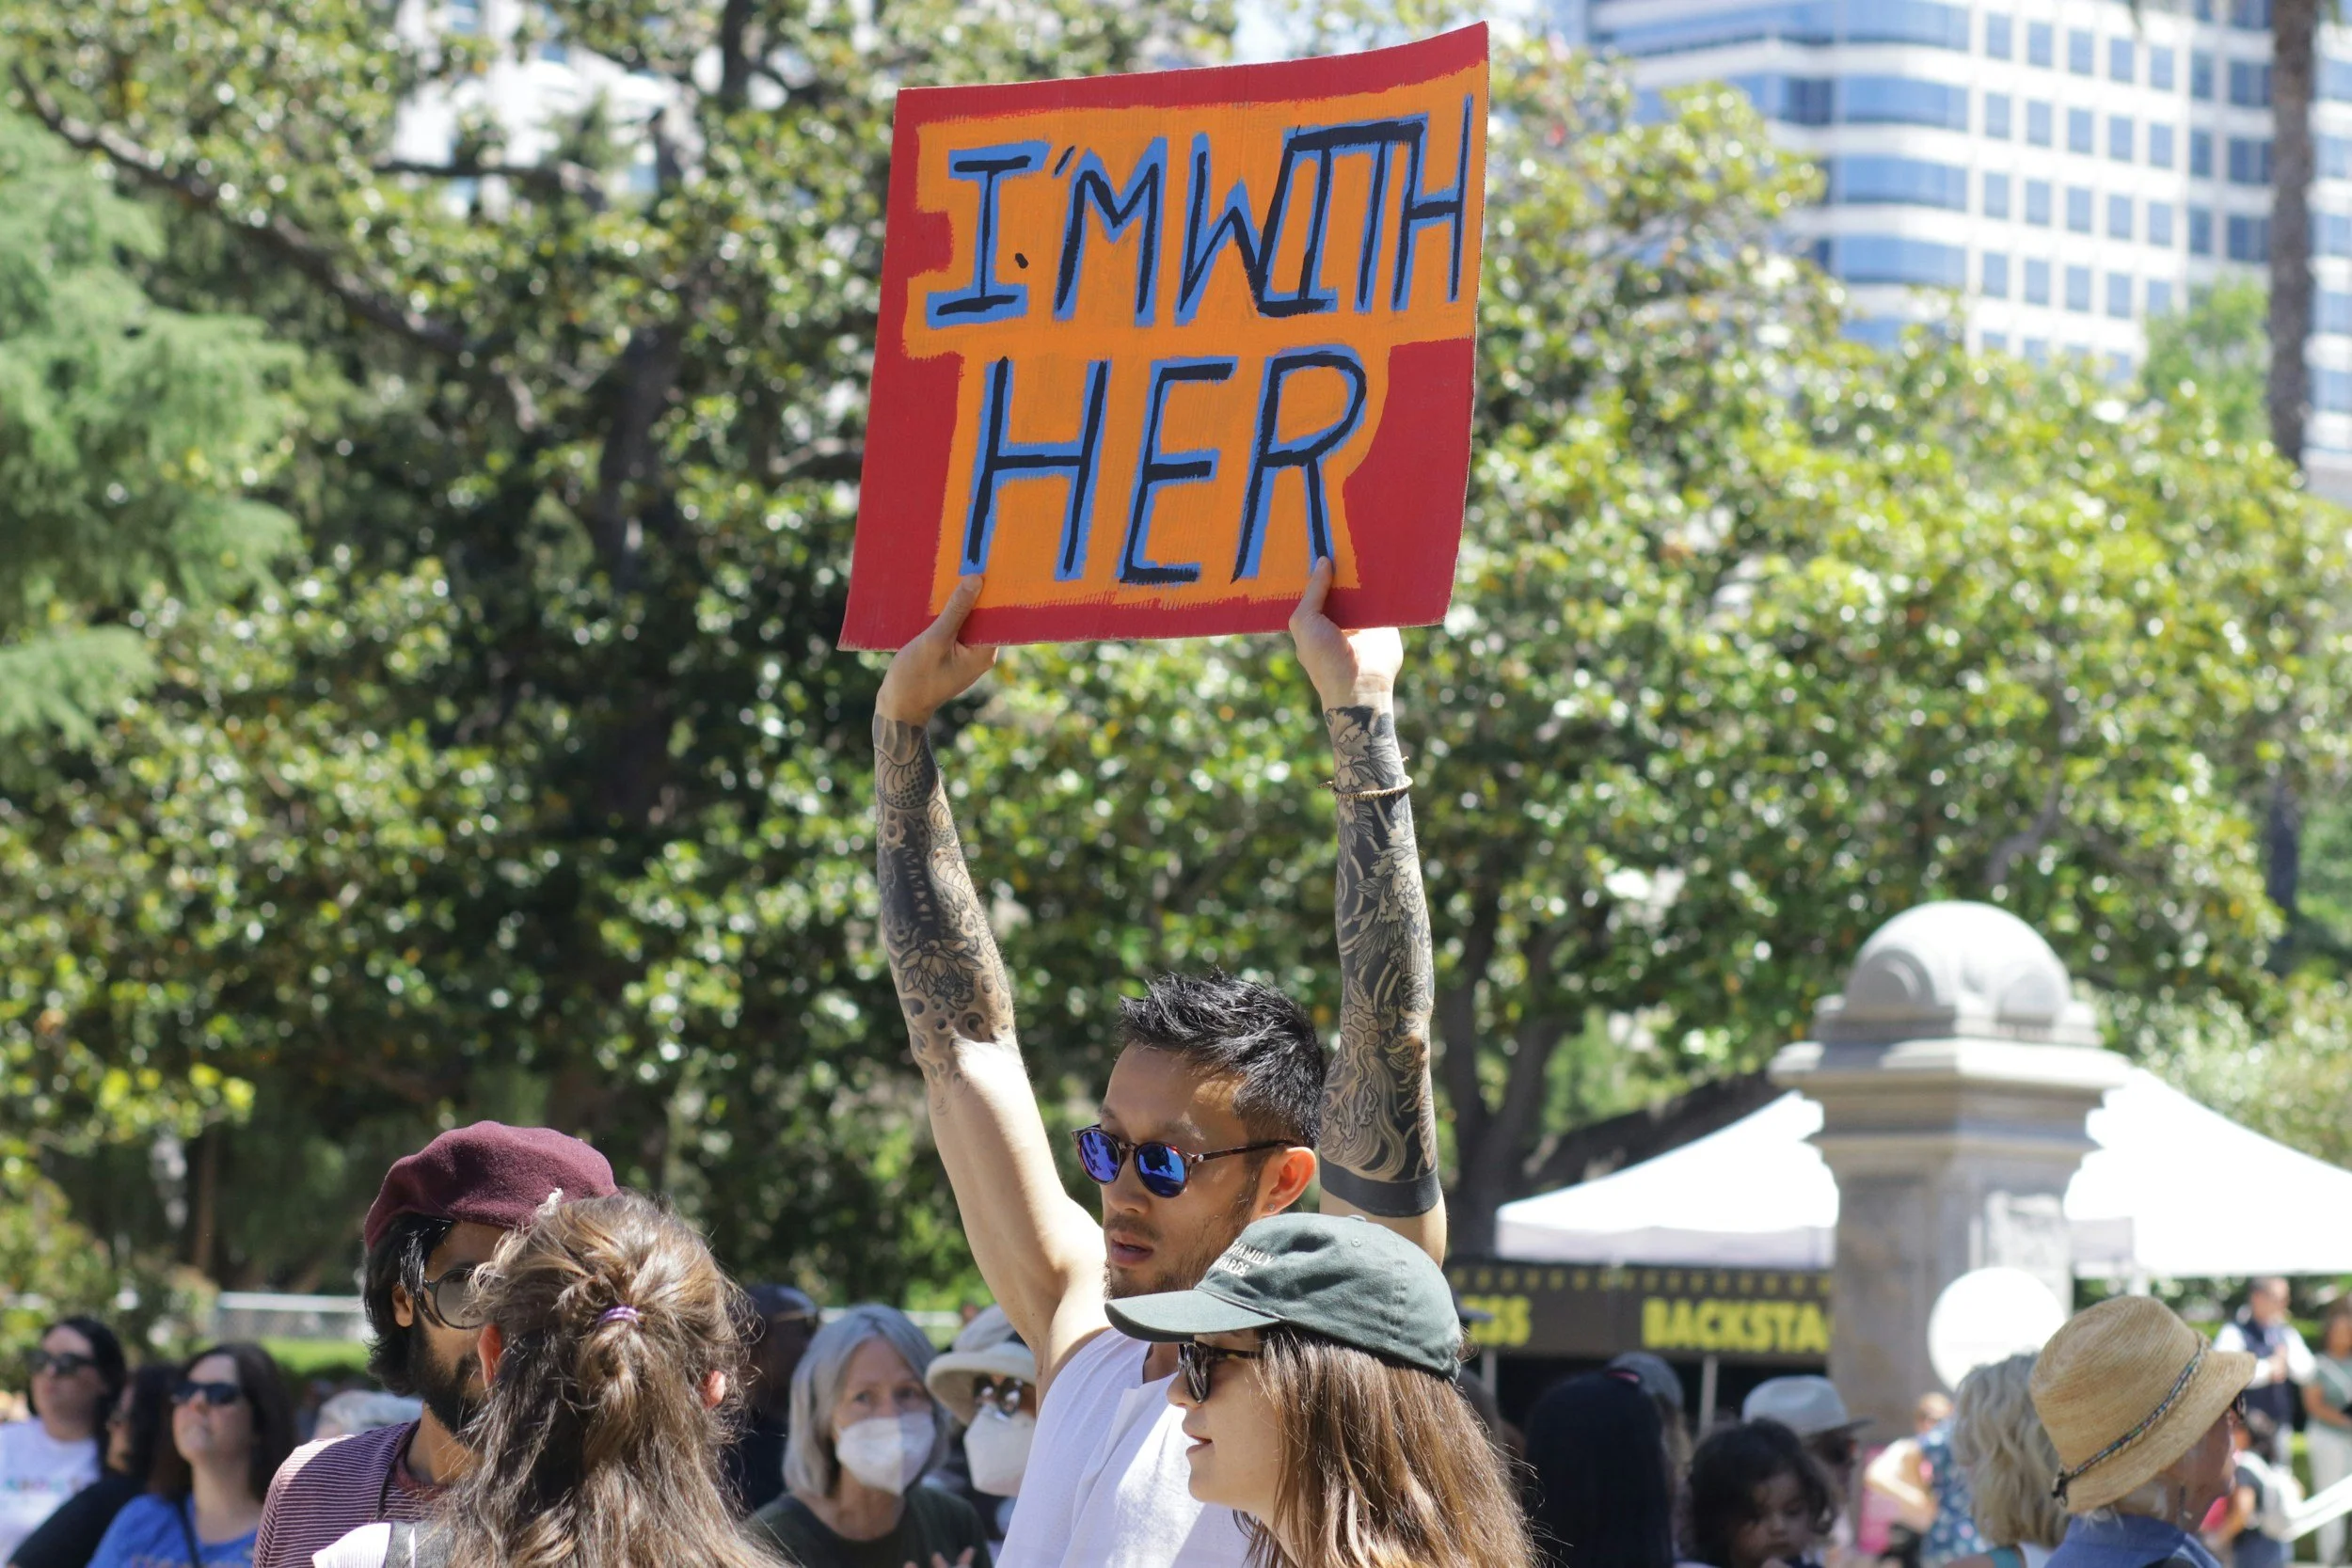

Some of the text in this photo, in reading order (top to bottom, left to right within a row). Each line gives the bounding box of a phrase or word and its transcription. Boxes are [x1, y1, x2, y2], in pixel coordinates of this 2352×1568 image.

[926, 94, 1473, 329] I'M WITH
[960, 344, 1366, 586] HER
